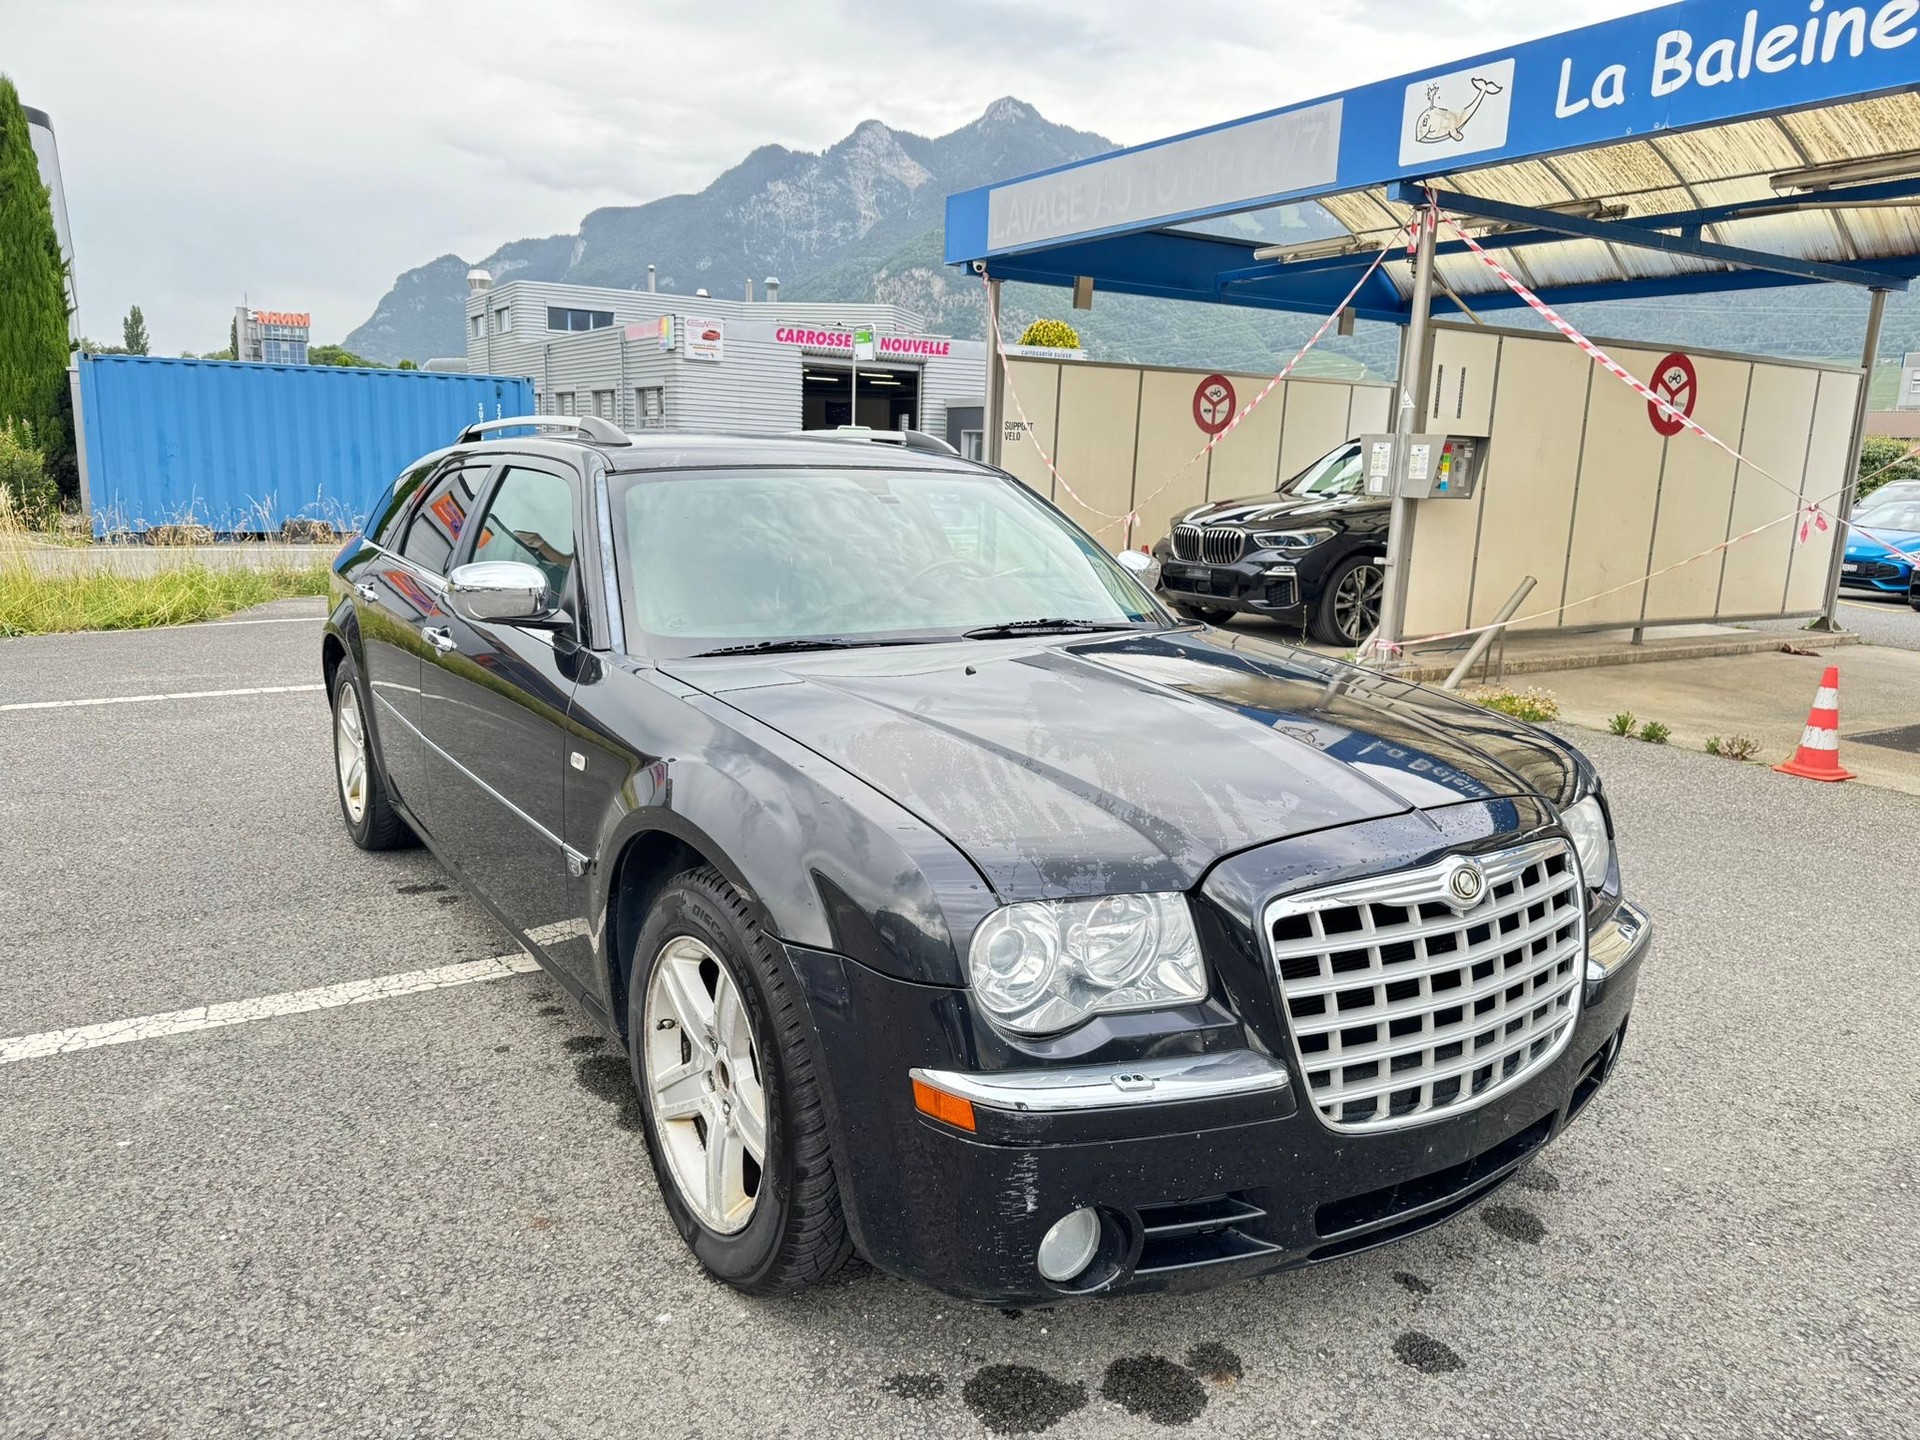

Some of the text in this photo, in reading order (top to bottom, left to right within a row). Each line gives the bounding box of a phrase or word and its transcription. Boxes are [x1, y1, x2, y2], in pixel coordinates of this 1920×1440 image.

[1555, 0, 1919, 119] La Baleine
[776, 328, 851, 347] CARROSSE
[880, 337, 950, 355] NOUVELLE
[1021, 349, 1054, 358] carrosserie
[1004, 432, 1021, 441] VELO
